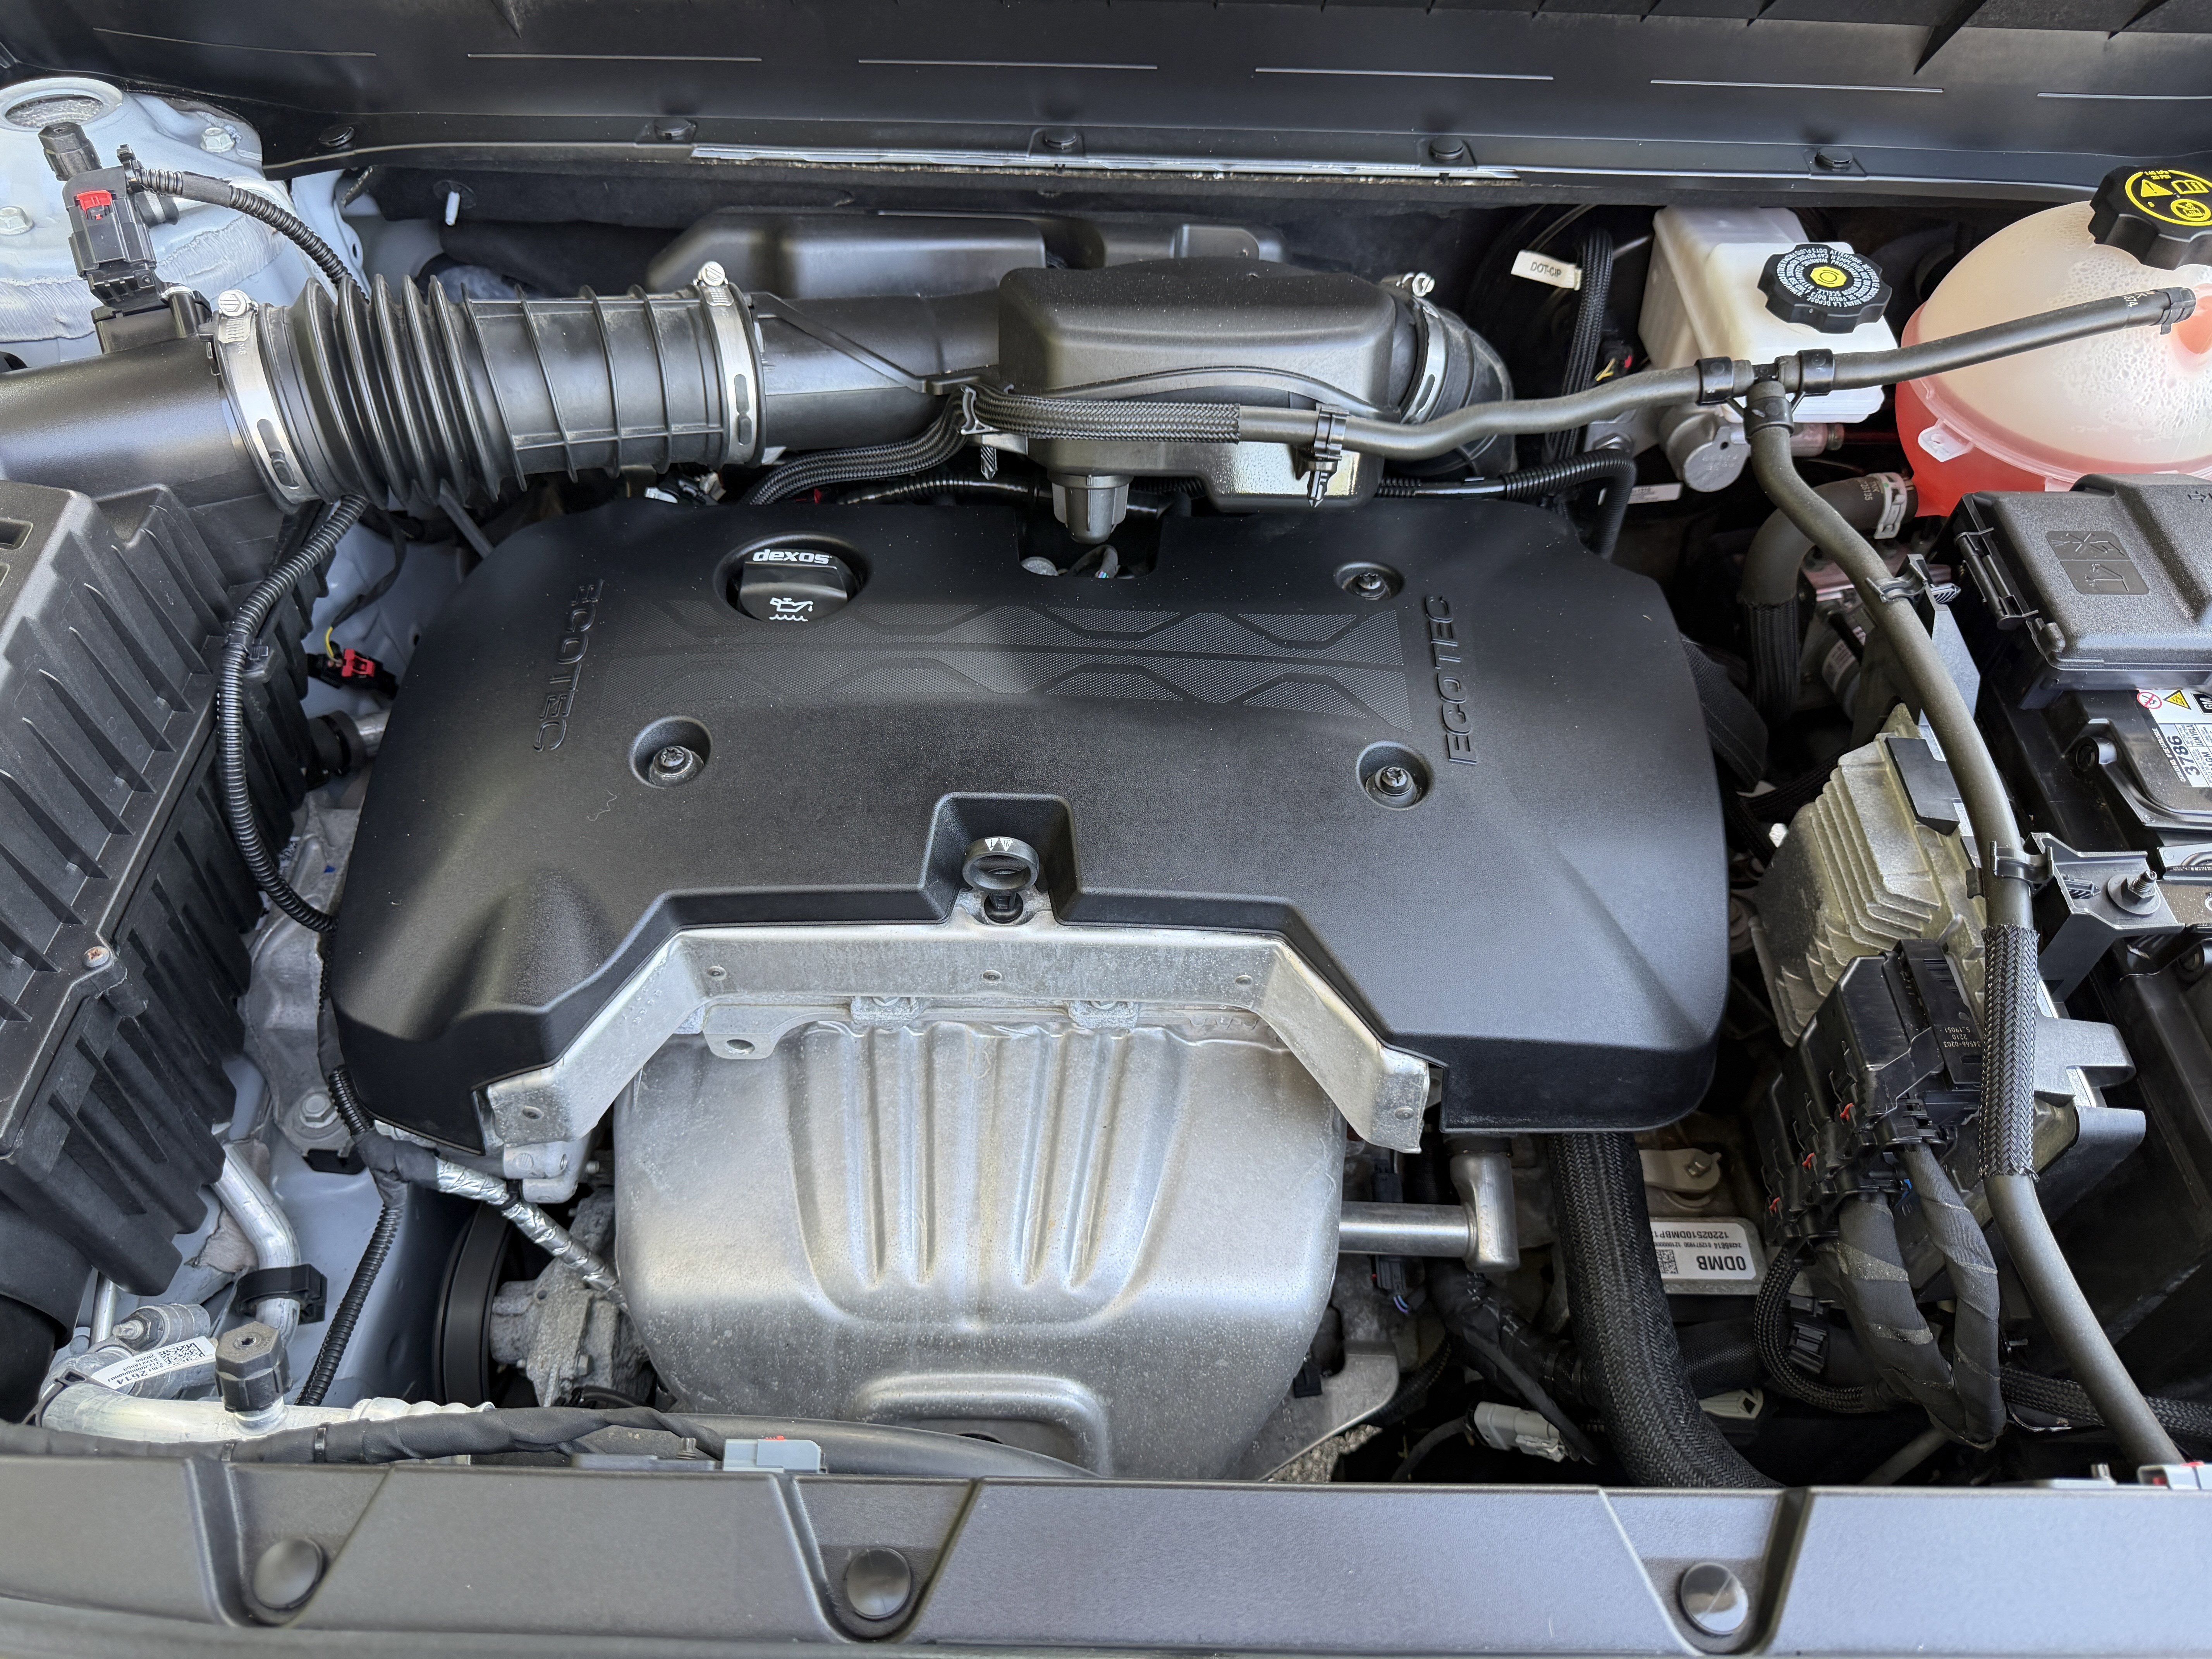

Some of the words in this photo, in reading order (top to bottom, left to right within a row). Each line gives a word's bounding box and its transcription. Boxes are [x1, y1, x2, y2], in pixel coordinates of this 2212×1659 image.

[753, 549, 829, 564] dexos
[533, 578, 604, 752] ECOTEC
[1424, 594, 1477, 765] ECOTEC
[2166, 736, 2202, 775] 3786
[1696, 1255, 1746, 1271] 0DMB
[115, 1370, 148, 1386] 2614
